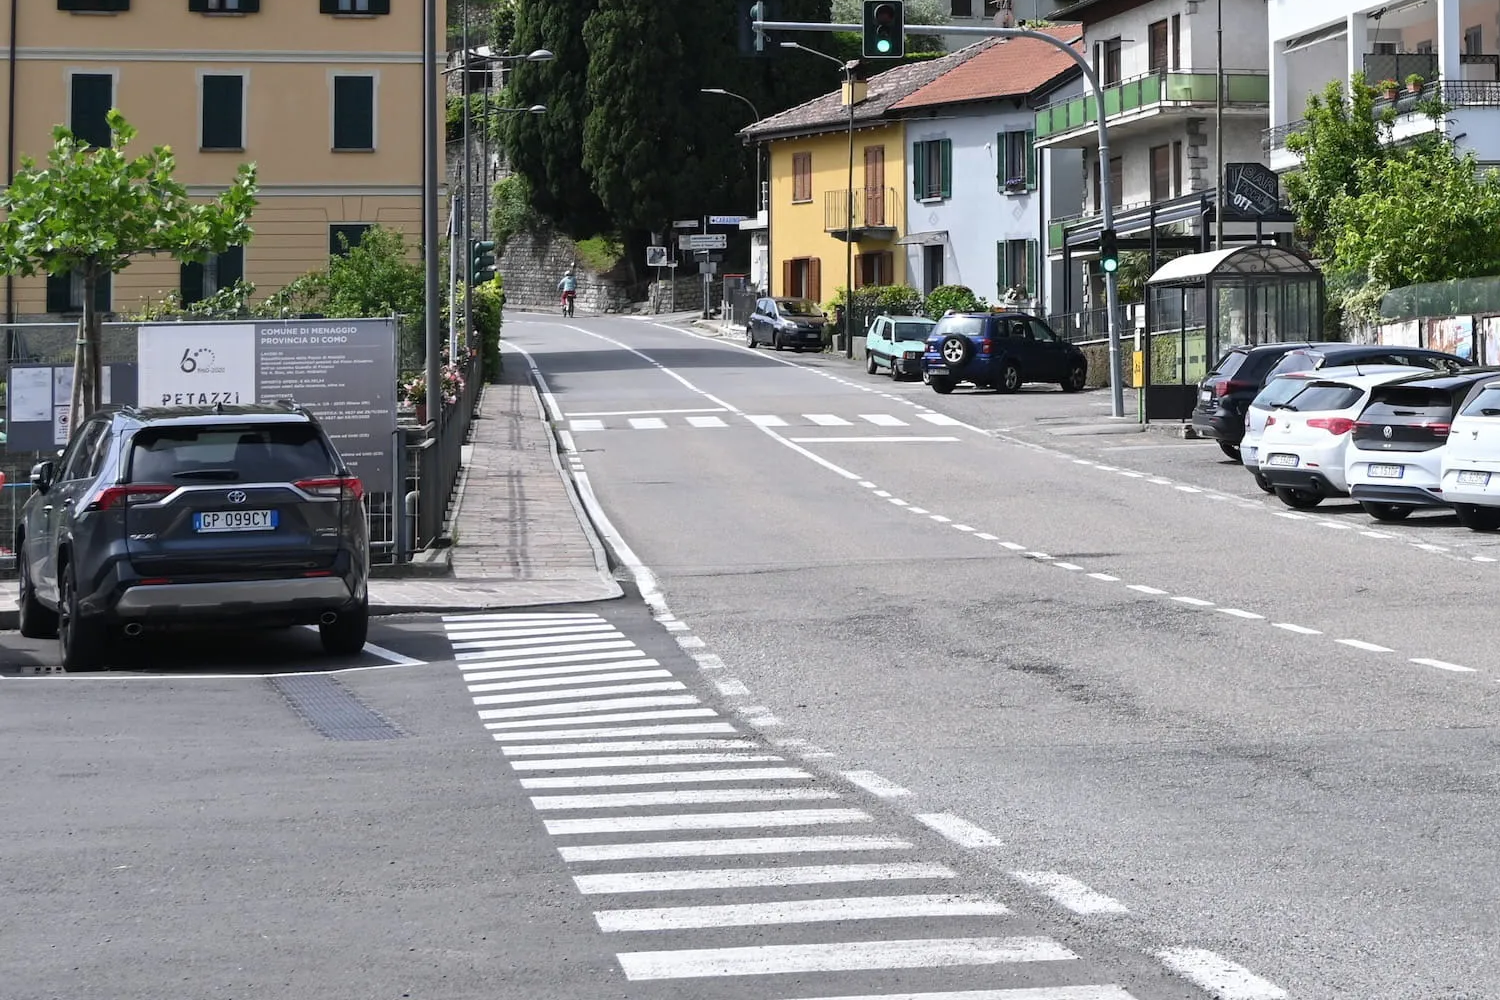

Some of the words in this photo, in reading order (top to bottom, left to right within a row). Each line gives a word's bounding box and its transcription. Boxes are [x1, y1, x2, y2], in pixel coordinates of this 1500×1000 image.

[261, 328, 298, 336] COMUNE
[311, 326, 358, 335] MENAGGIO
[261, 337, 308, 345] PROVINCIA
[321, 336, 348, 344] COMO
[161, 391, 239, 407] PETAZZI
[203, 513, 220, 527] GP
[225, 512, 268, 527] 099CY
